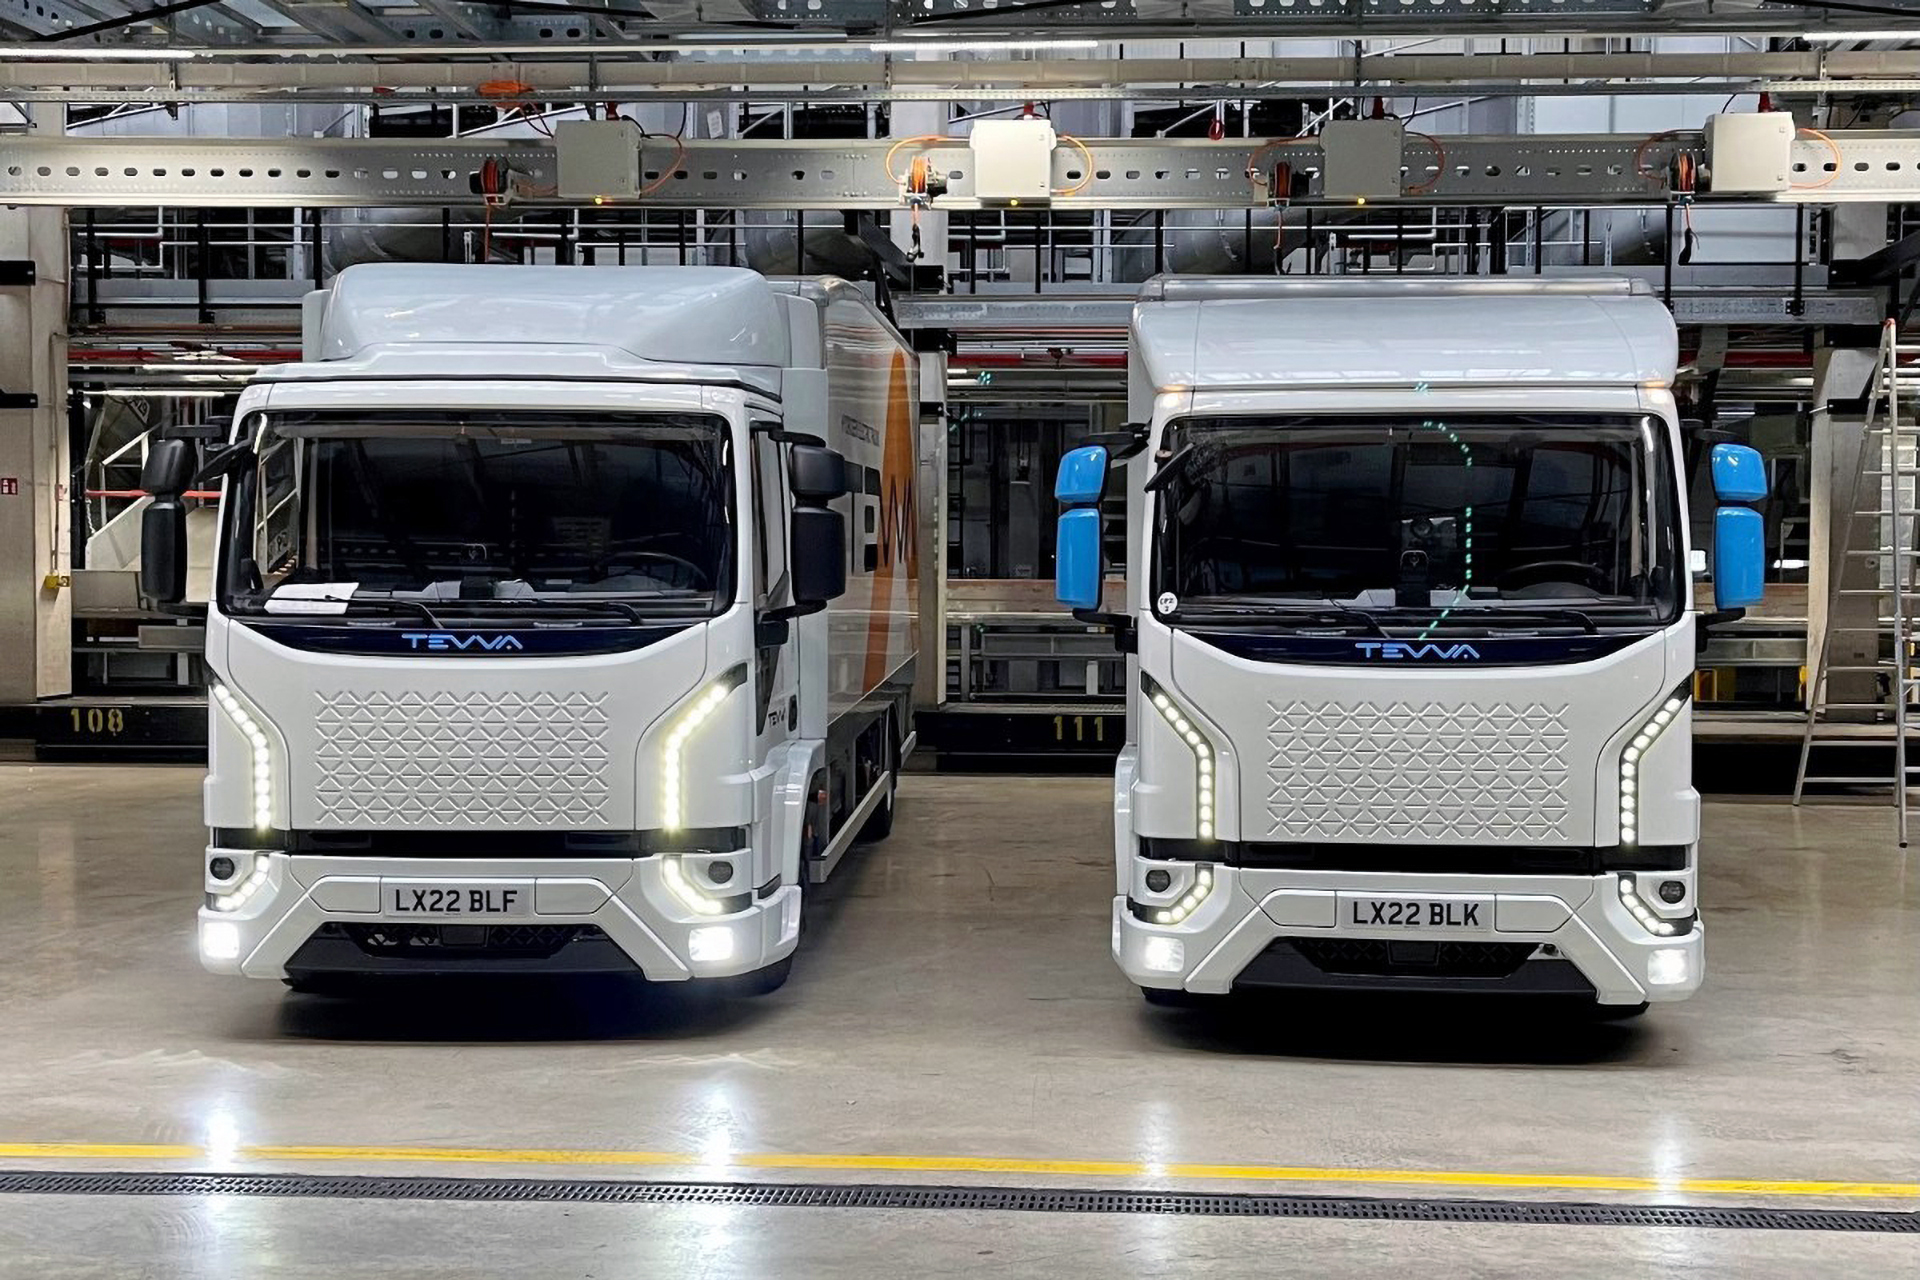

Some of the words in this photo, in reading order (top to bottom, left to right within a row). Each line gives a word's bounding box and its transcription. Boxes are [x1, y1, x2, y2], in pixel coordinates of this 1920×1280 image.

[401, 633, 524, 650] TEVVA
[1355, 642, 1481, 659] TEVVA
[71, 708, 124, 734] 108
[1053, 715, 1104, 741] 111
[395, 889, 461, 912] LX22
[468, 889, 518, 913] BLF
[1353, 901, 1421, 925] LX22
[1428, 902, 1479, 926] BLK
